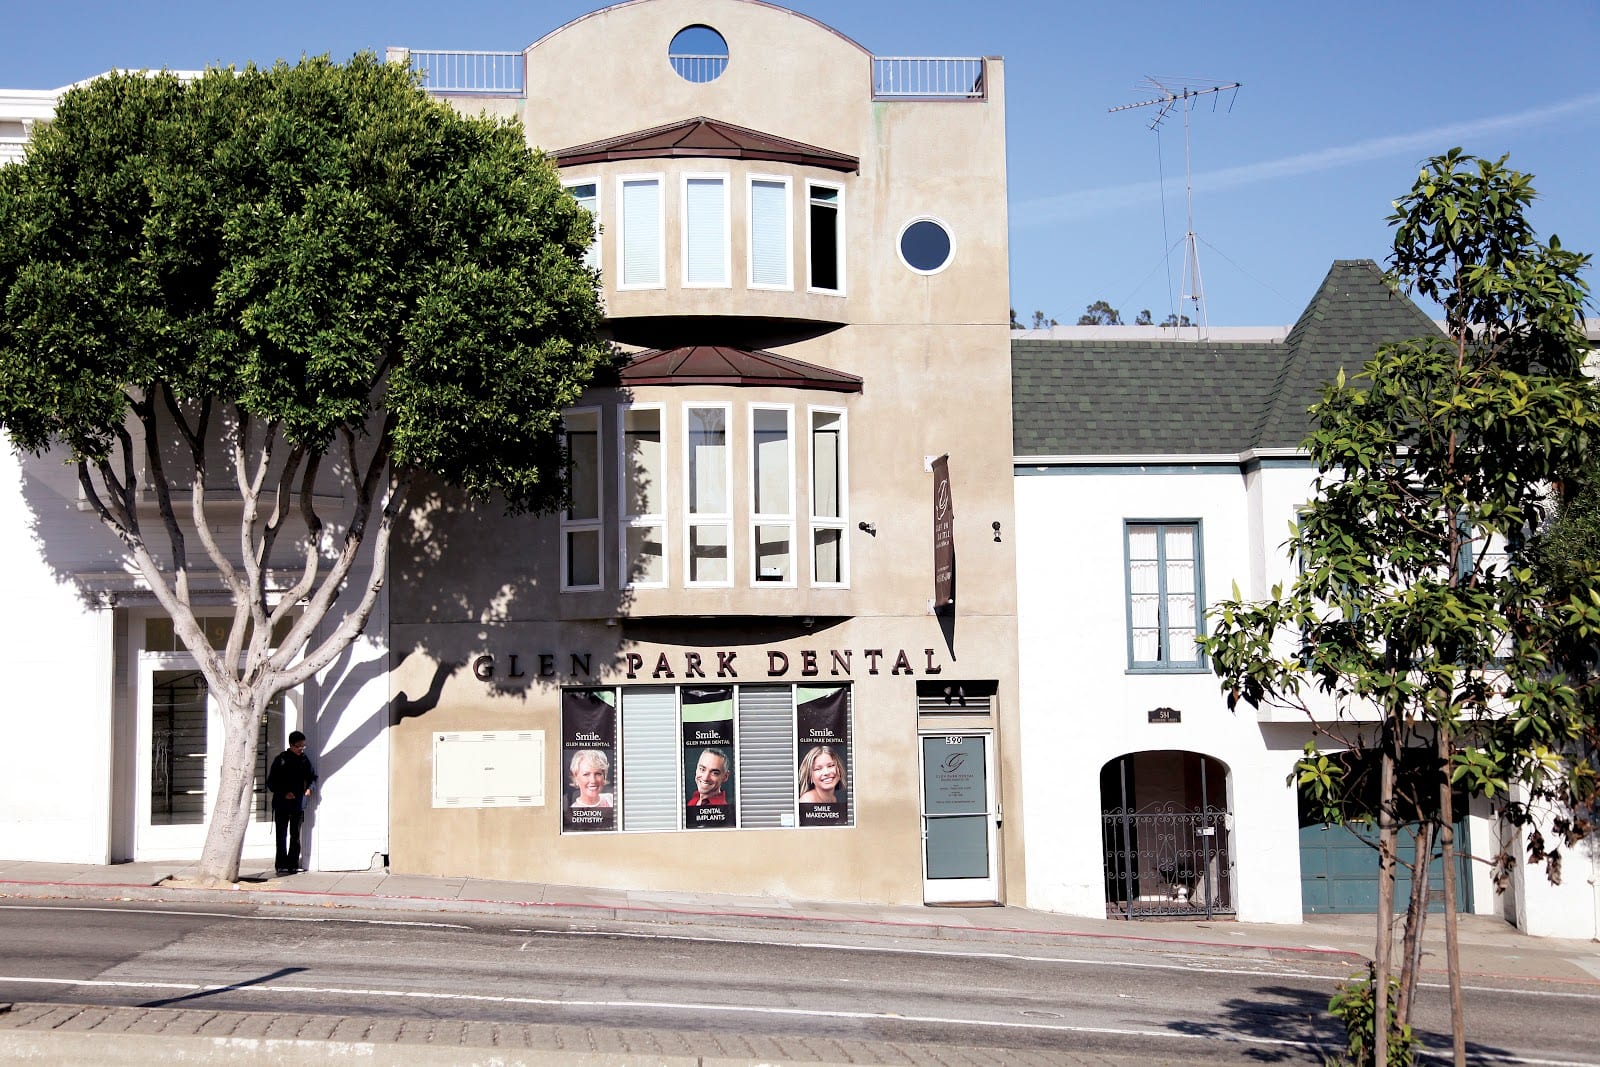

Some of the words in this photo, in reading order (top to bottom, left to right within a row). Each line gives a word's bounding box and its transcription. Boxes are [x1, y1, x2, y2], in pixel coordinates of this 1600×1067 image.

[472, 653, 592, 682] GLEN
[626, 651, 738, 679] PARK
[766, 649, 942, 677] DENTAL
[946, 736, 962, 744] 590
[699, 807, 723, 815] DENTAL
